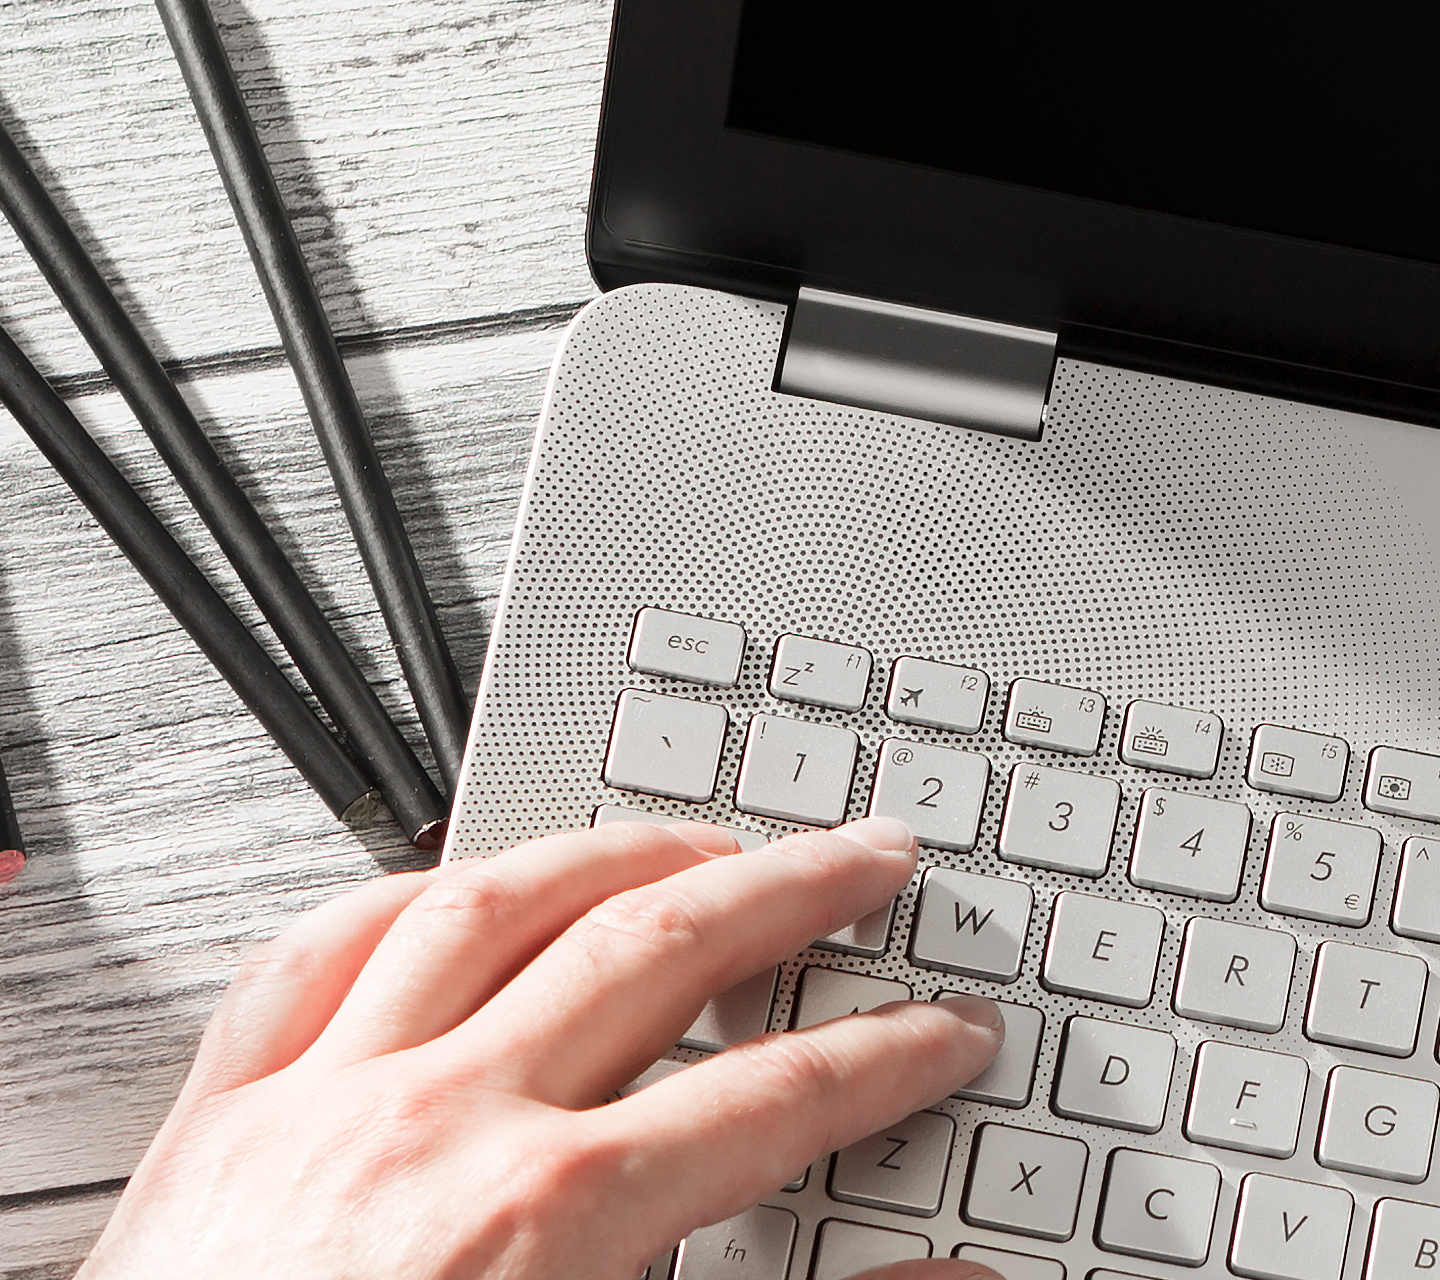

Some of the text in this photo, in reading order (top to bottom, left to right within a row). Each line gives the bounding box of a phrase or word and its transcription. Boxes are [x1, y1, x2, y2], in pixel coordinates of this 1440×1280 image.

[668, 636, 708, 653] esc
[847, 654, 861, 669] f1
[961, 676, 977, 691] f2
[1079, 697, 1095, 712] f3
[1195, 720, 1210, 734] f4
[1322, 744, 1338, 758] f5
[794, 753, 806, 782] 1
[917, 778, 943, 807] 2
[1049, 802, 1073, 831] 3
[1180, 829, 1204, 857] 4
[1310, 852, 1335, 880] 5
[955, 902, 993, 935] W
[1092, 931, 1116, 961] E
[1225, 955, 1248, 986] R
[1360, 980, 1380, 1008] T
[1100, 1056, 1129, 1085] D
[1236, 1081, 1260, 1109] F
[1365, 1106, 1397, 1136] G
[877, 1137, 908, 1169] Z
[1011, 1162, 1041, 1195] X
[1145, 1189, 1174, 1220] C
[1283, 1212, 1307, 1242] V
[725, 1239, 746, 1261] fn
[1415, 1239, 1438, 1268] B
